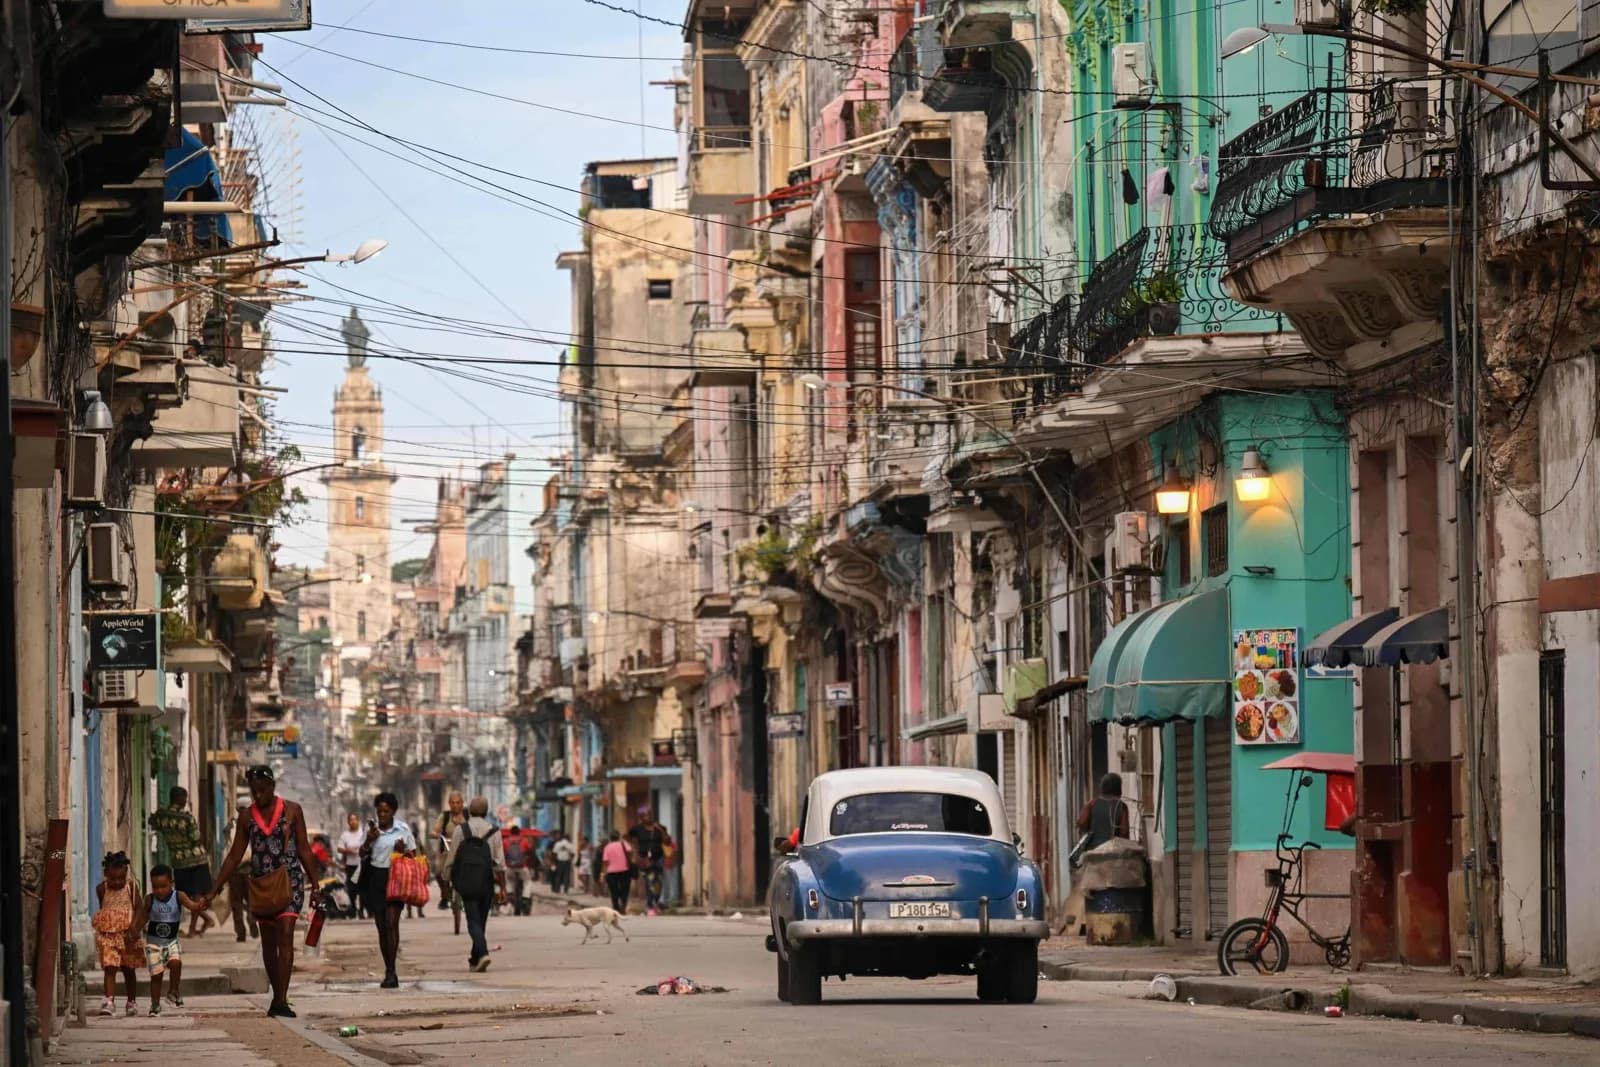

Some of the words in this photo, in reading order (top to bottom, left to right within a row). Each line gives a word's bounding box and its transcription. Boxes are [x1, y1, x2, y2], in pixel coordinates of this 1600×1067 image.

[102, 619, 145, 629] AppleWorld
[1238, 630, 1296, 643] ALGARBIA
[897, 904, 905, 916] P
[906, 904, 926, 916] 180
[928, 904, 948, 916] 154
